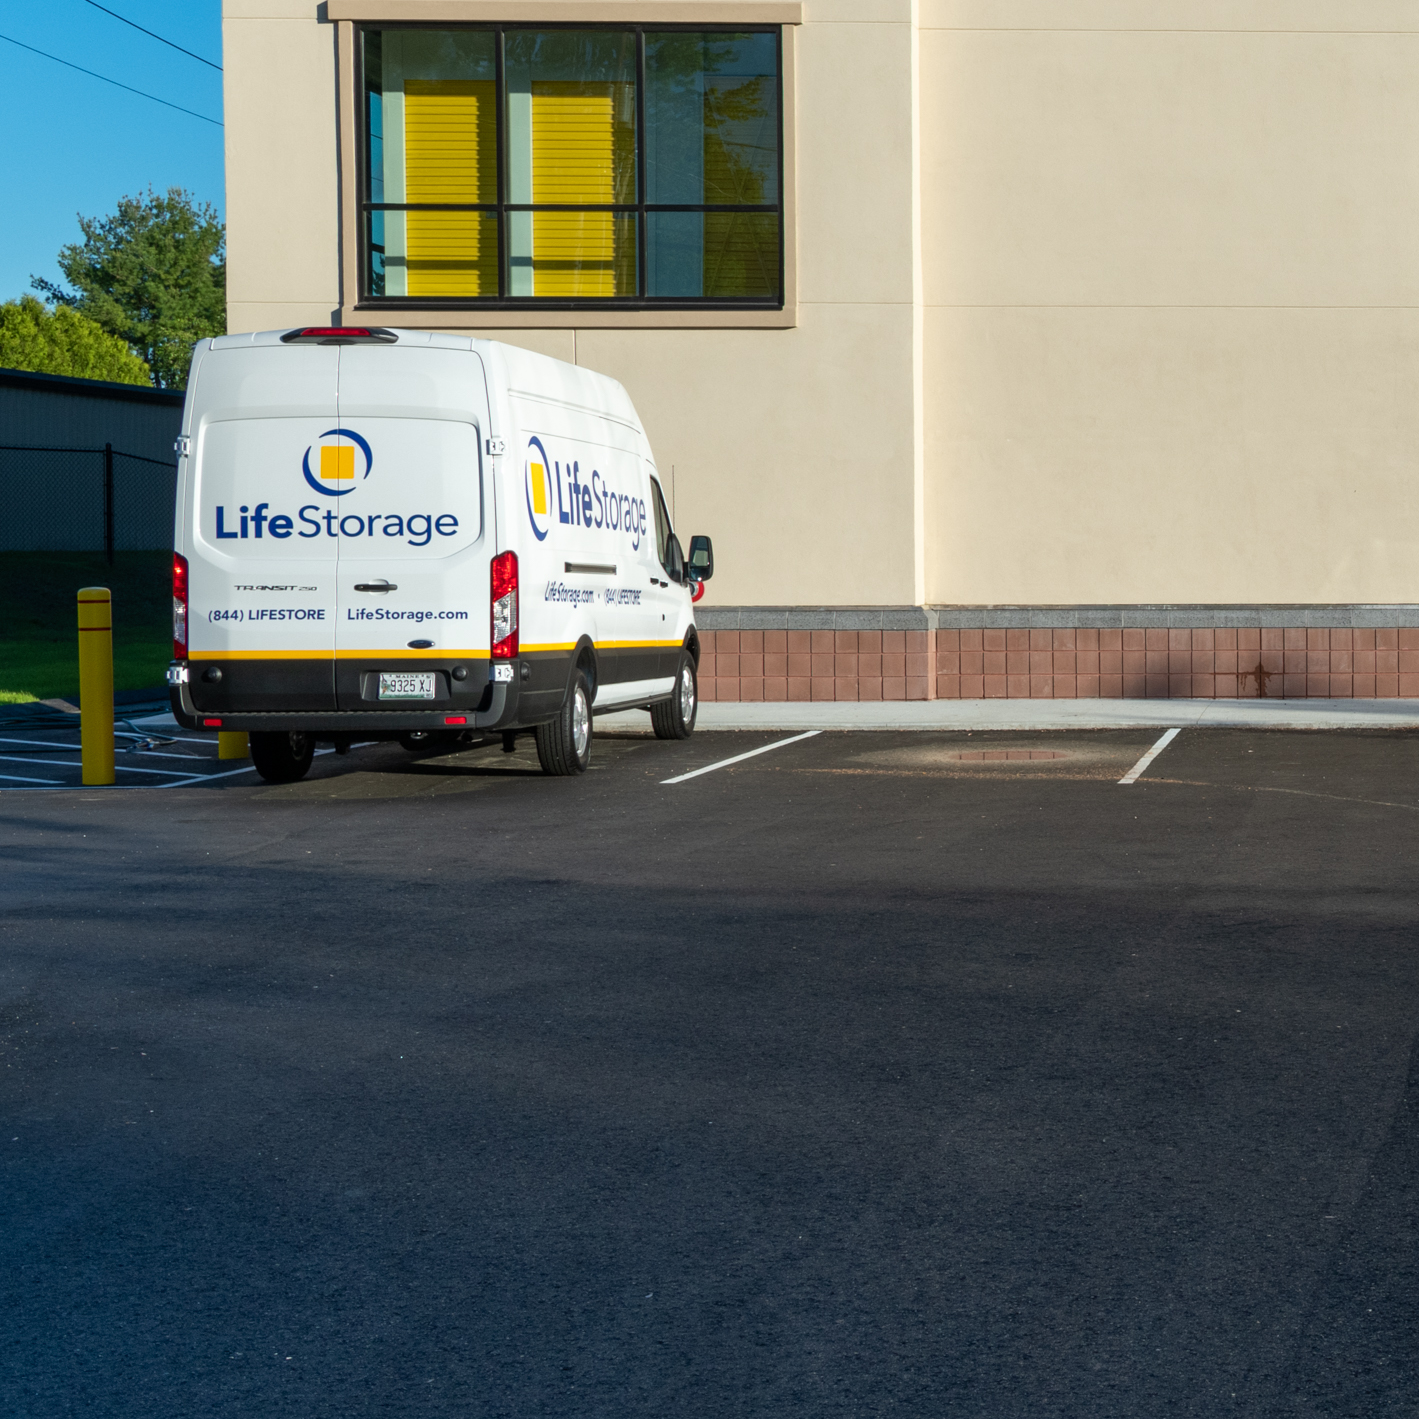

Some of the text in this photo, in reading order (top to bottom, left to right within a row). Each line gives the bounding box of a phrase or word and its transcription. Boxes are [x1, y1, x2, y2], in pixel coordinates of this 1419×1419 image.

[555, 461, 647, 552] LifeStorage
[215, 503, 459, 547] LifeStorage
[545, 580, 595, 609] LifeStorage.com
[208, 608, 469, 623] (844) LIFESTORE LifeStorage.com
[390, 679, 432, 693] 9325 XJ
